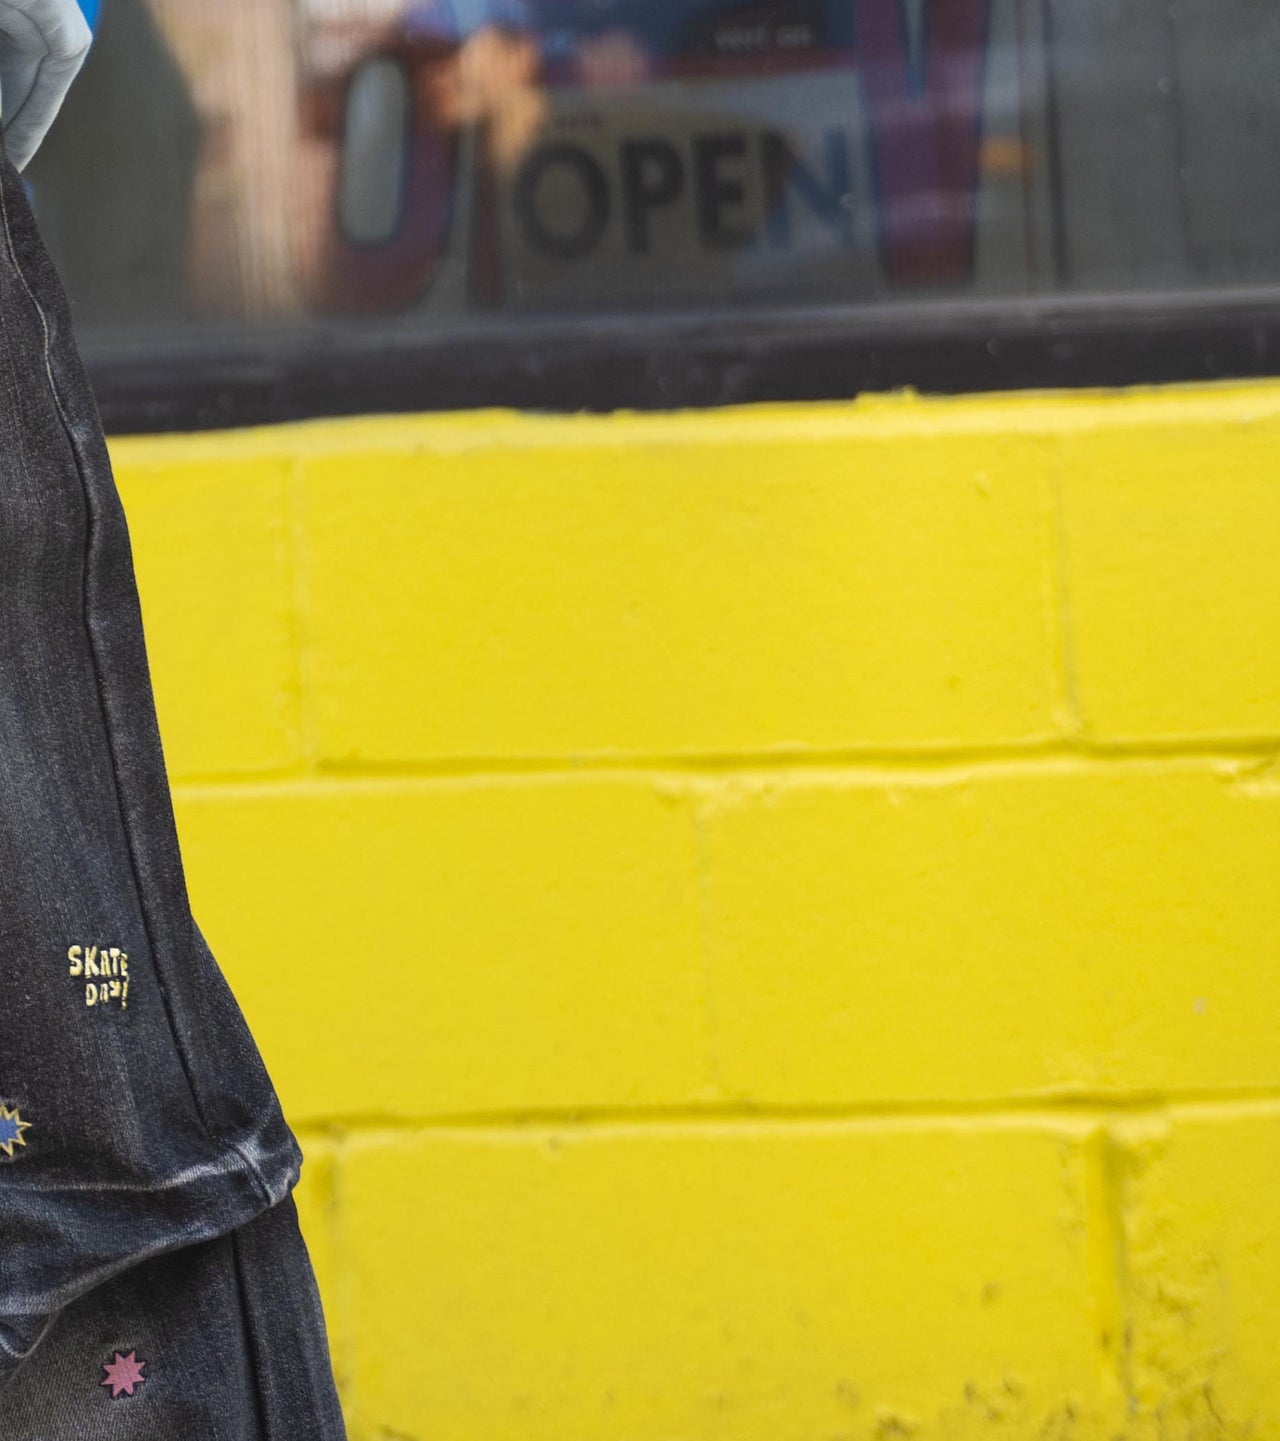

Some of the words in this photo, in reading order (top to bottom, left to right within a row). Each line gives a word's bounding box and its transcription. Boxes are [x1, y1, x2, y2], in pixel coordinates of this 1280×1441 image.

[514, 125, 858, 260] OPEN
[68, 945, 129, 979] SKATE
[85, 980, 129, 1009] DAY!
